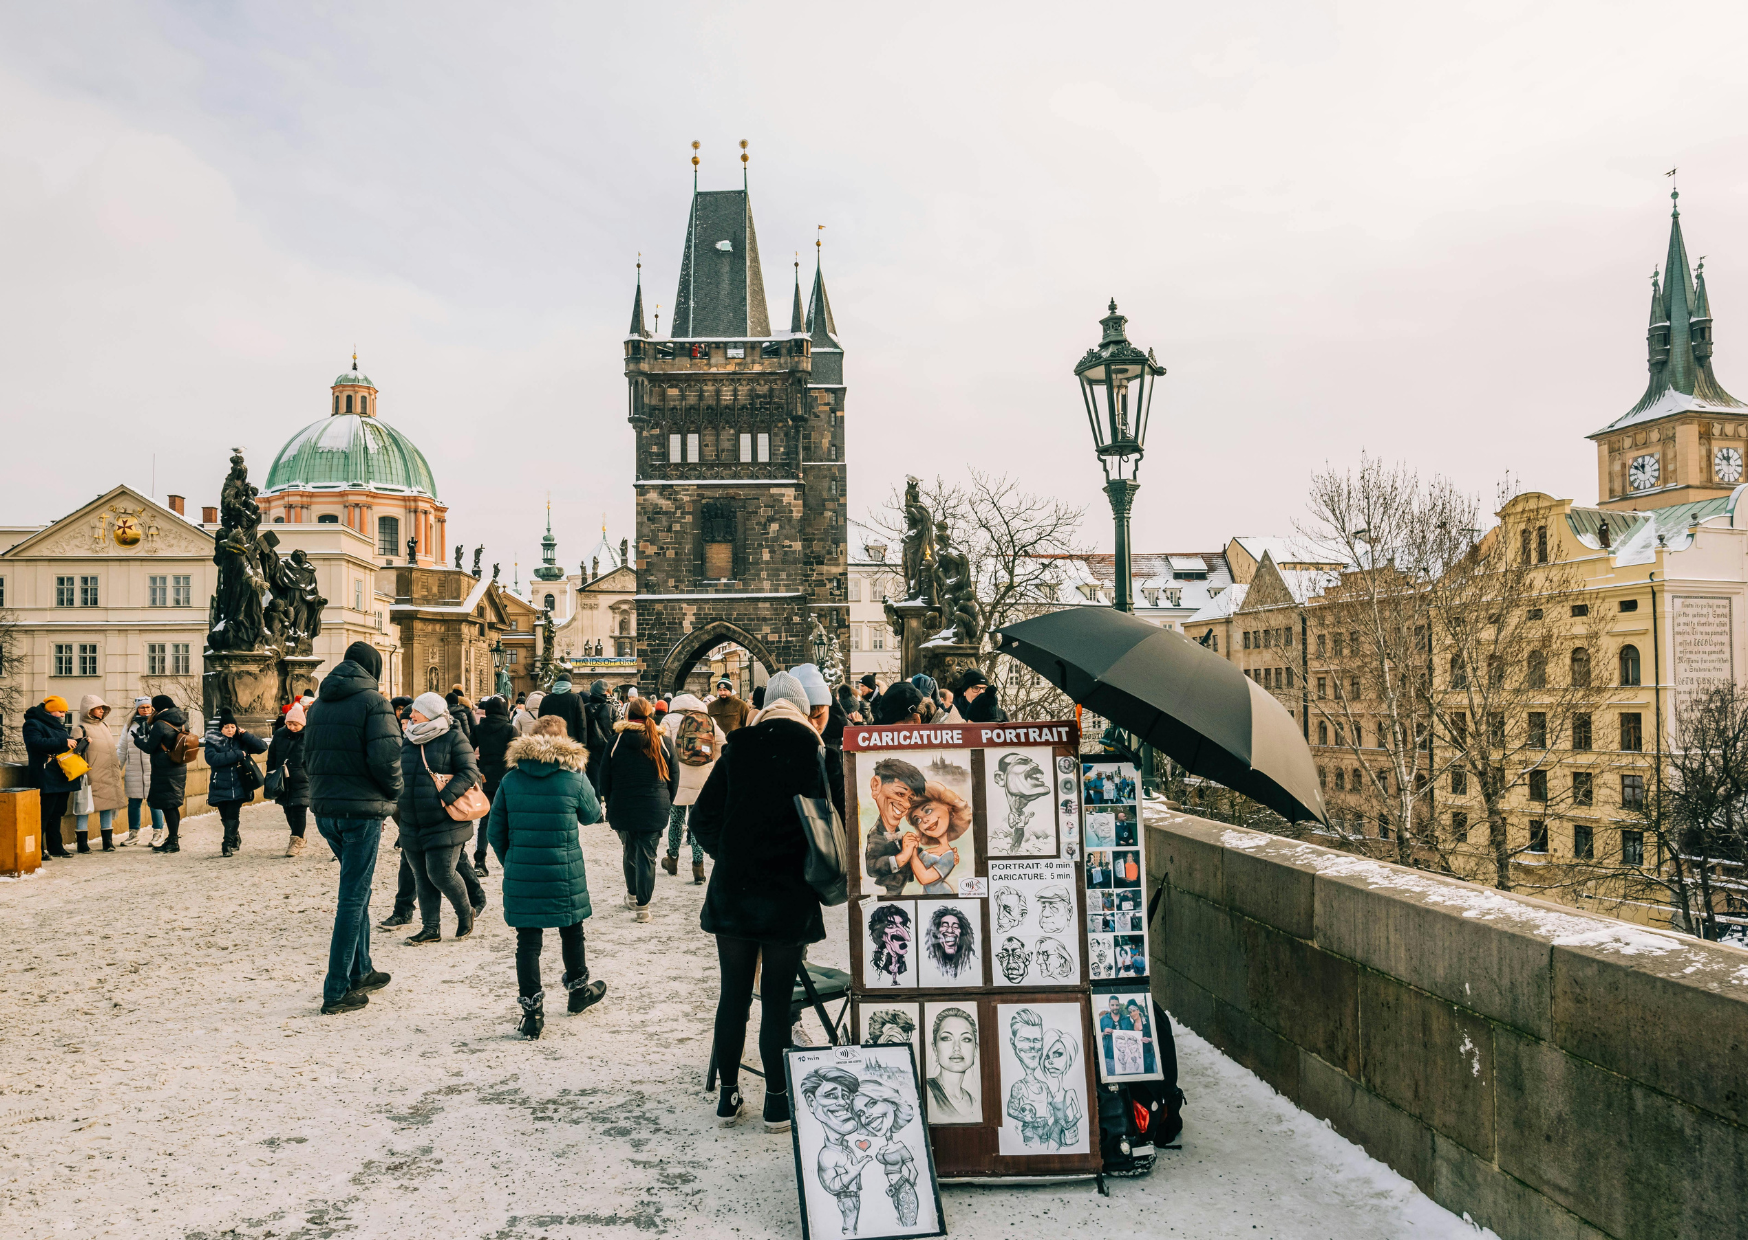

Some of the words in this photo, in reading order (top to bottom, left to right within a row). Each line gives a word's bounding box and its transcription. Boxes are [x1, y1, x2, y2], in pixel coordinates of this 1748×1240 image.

[575, 658, 603, 666] HANDS
[603, 658, 616, 666] OFF
[858, 729, 963, 747] CARICATURE
[981, 727, 1070, 743] PORTRAIT
[991, 862, 1042, 870] PORTRAIT:
[992, 873, 1047, 881] CARICATURE:
[1050, 872, 1055, 880] 5
[1056, 872, 1073, 880] min.
